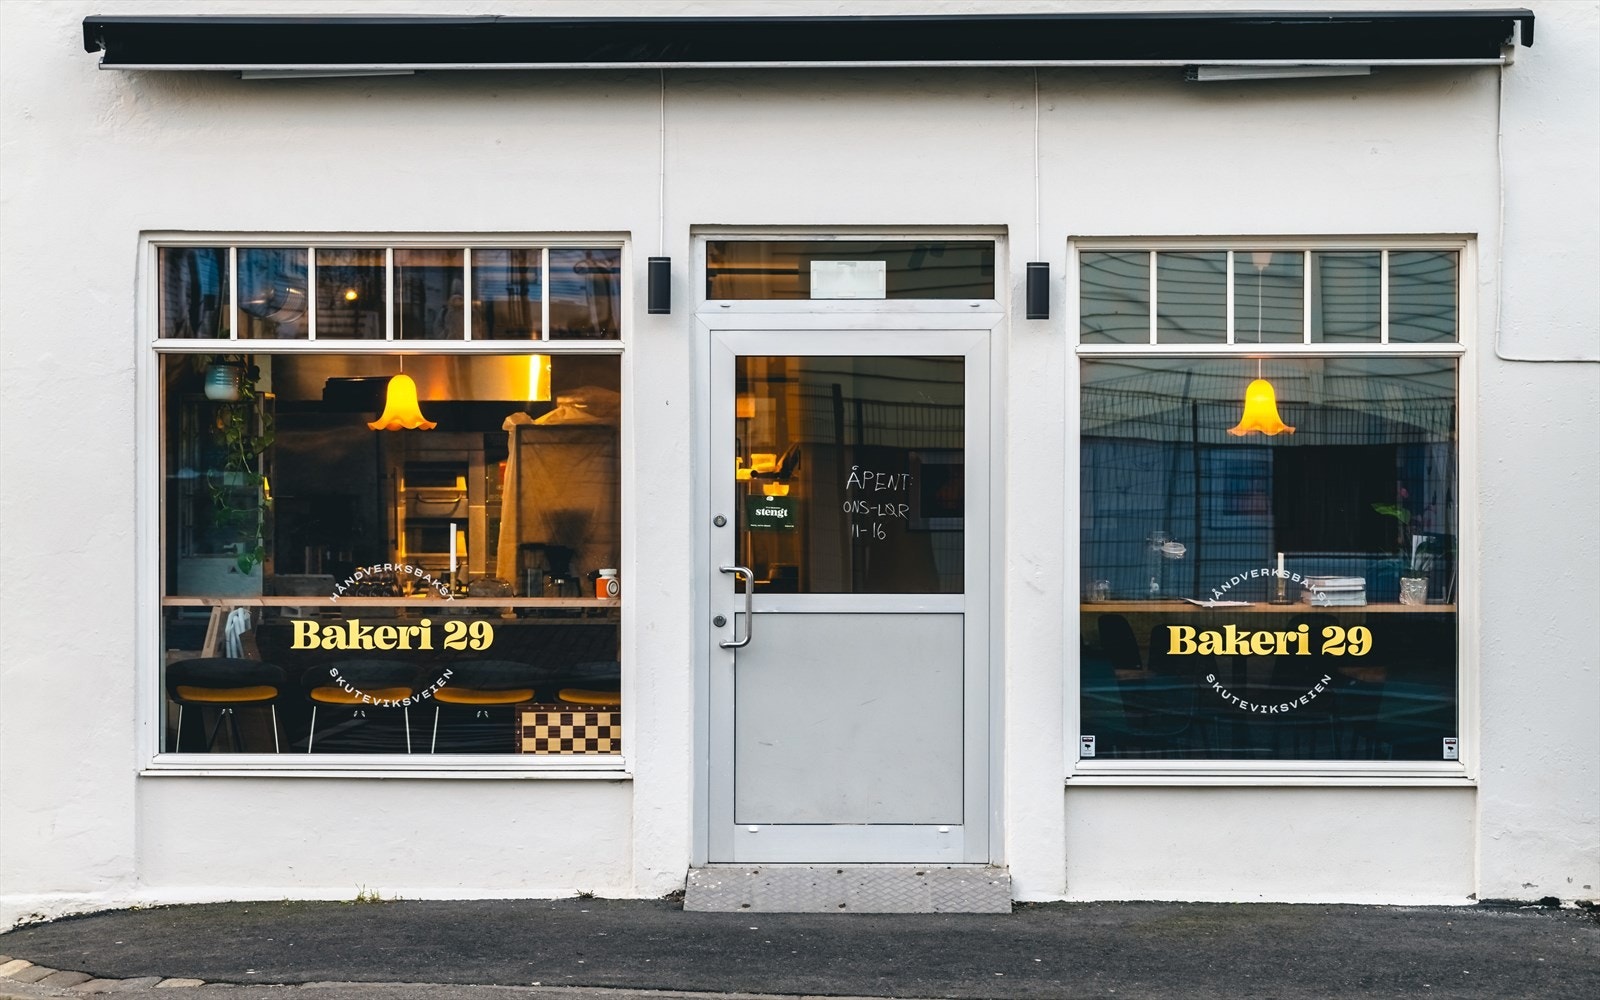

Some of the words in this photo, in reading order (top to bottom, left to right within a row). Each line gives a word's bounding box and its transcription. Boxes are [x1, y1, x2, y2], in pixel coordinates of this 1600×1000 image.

[755, 508, 788, 518] stengt
[329, 563, 455, 603] HÅNDVERKSBAKST
[290, 618, 434, 650] Bakeri
[443, 620, 494, 651] 29
[1166, 623, 1312, 656] Bakeri
[1321, 625, 1373, 656] 29
[329, 668, 454, 708] SKUTEVIKSVEIEN
[1206, 673, 1332, 714] SKUTEVIKSVEIEN
